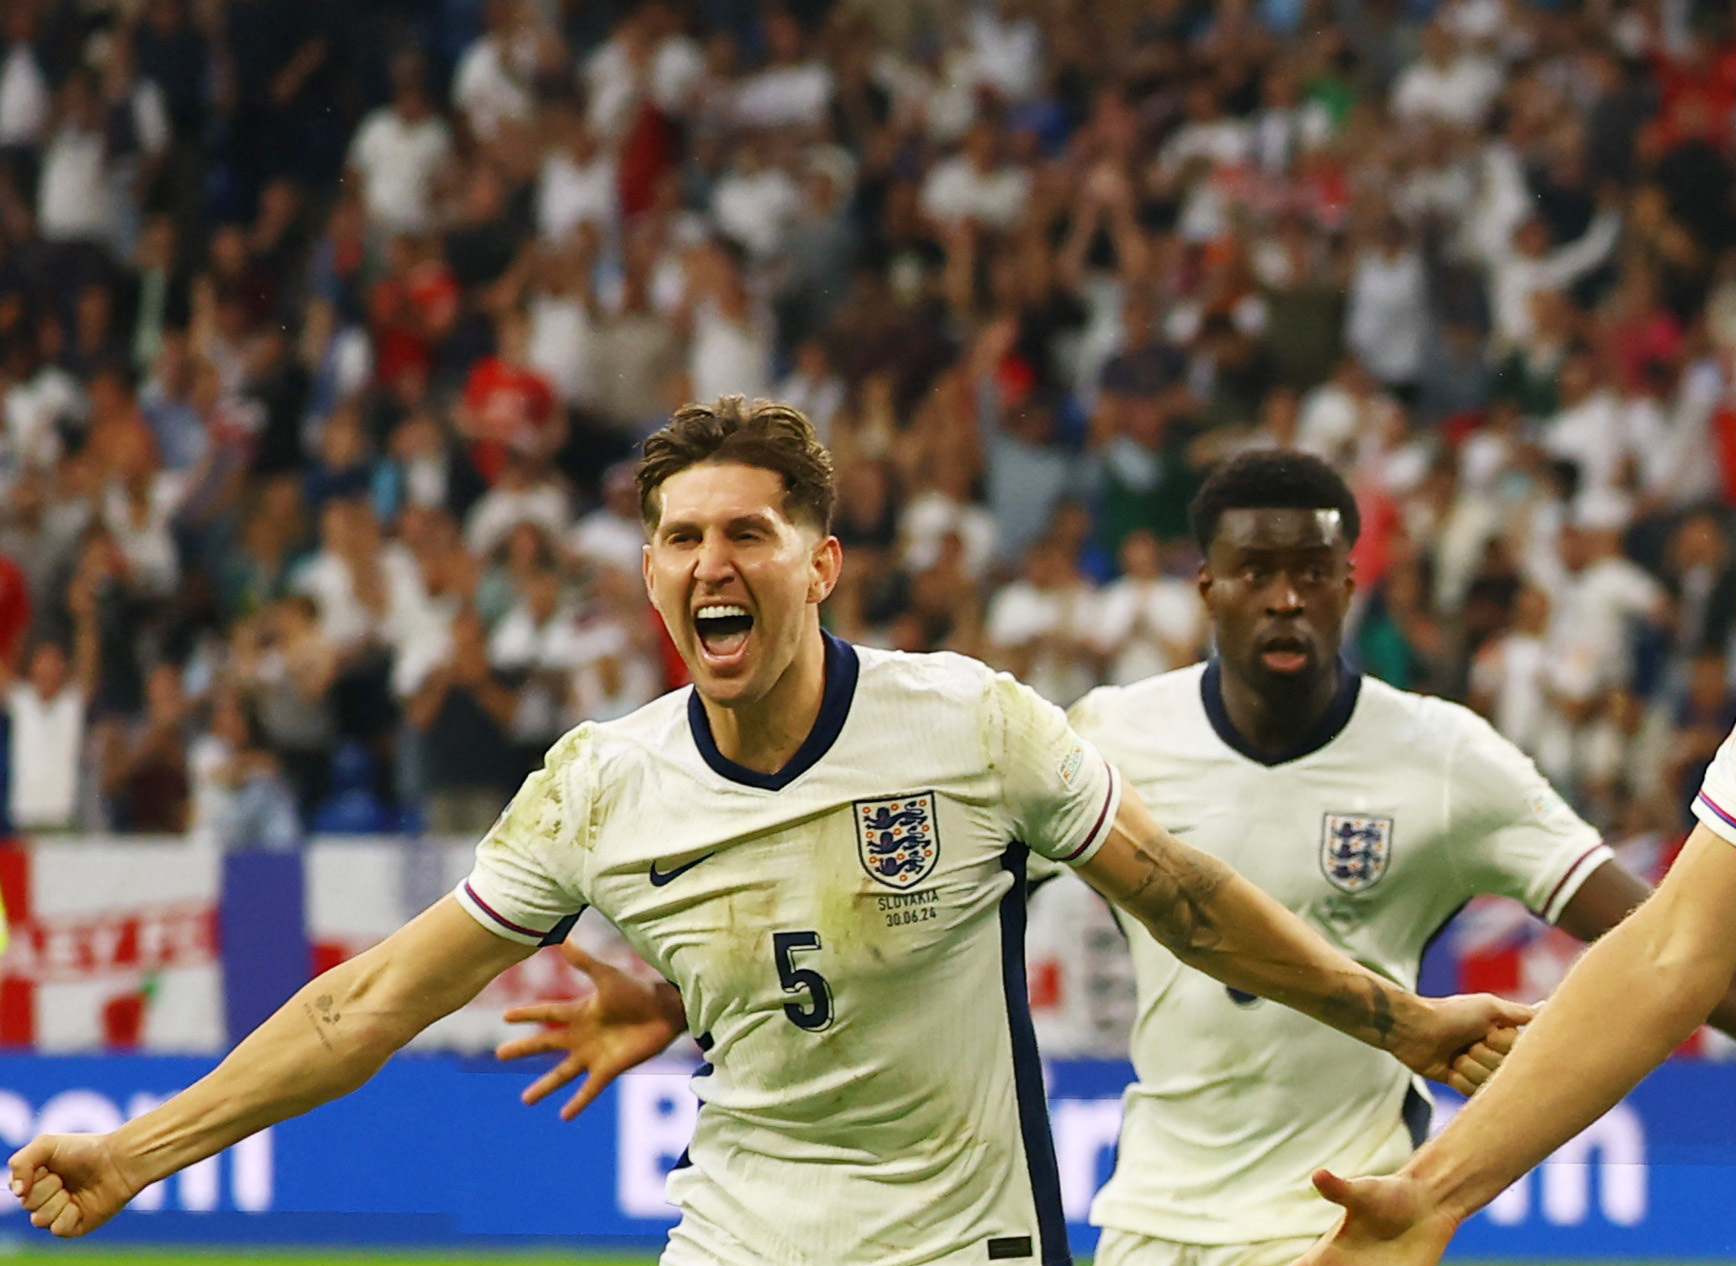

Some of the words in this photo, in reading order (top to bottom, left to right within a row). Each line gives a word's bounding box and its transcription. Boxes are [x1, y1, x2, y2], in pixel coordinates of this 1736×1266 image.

[878, 888, 939, 911] SLOVAKIA
[886, 907, 936, 927] 30.06.24
[773, 931, 834, 1032] 5
